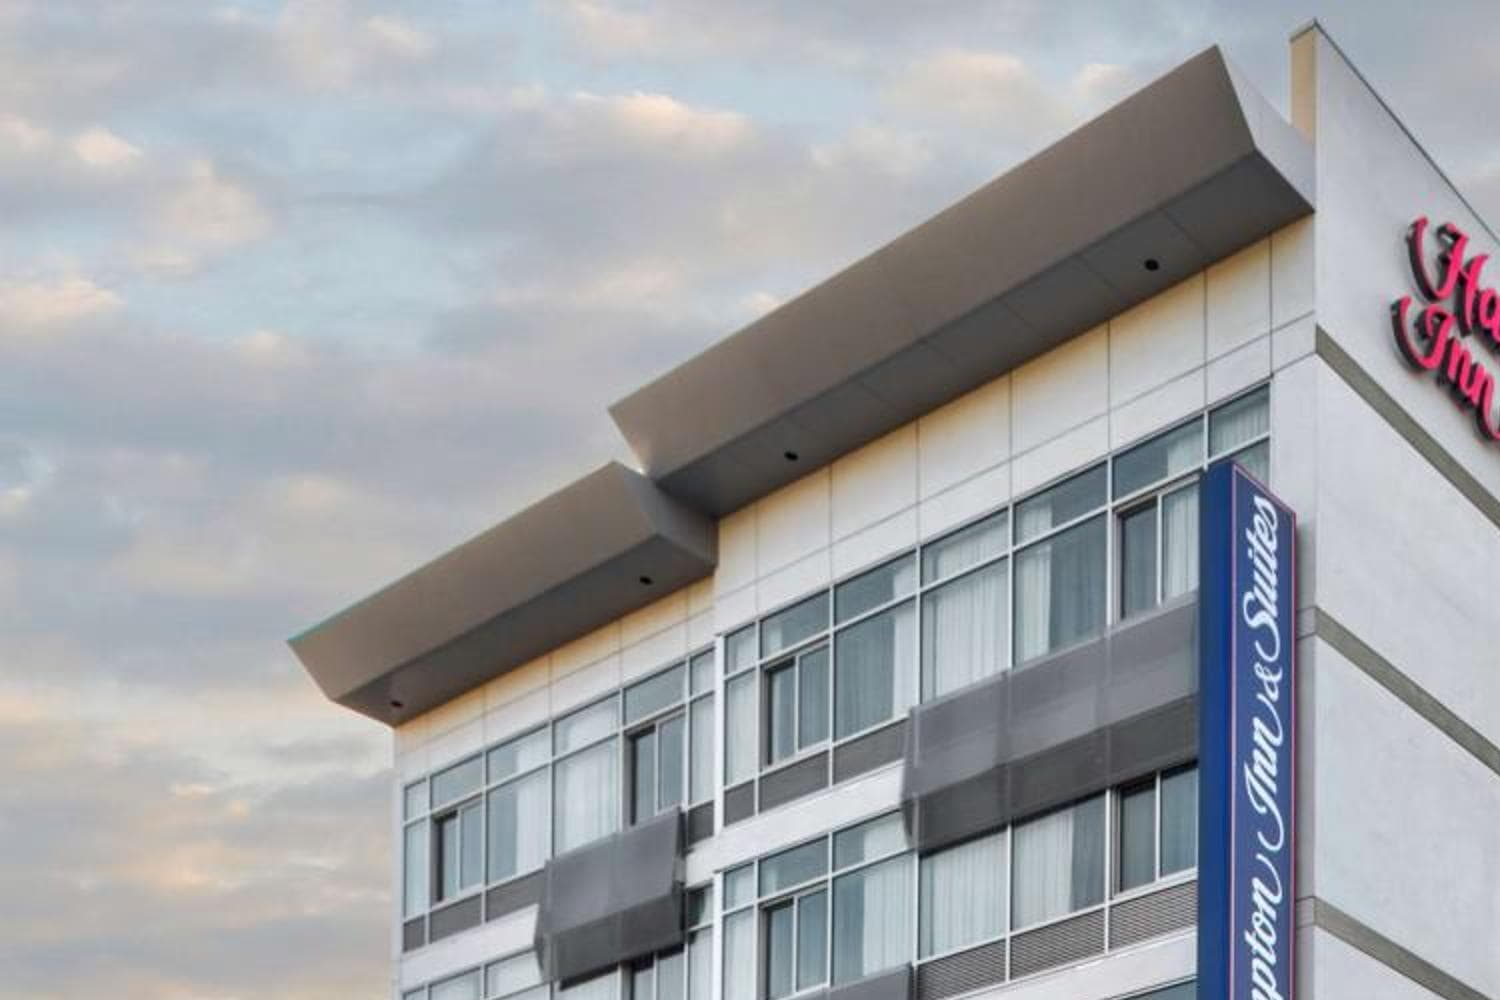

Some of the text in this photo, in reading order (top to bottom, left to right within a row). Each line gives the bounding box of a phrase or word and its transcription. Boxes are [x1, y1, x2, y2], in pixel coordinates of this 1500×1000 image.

[1242, 495, 1281, 662] Suites
[1254, 662, 1283, 702] &
[1243, 694, 1284, 851] Inn
